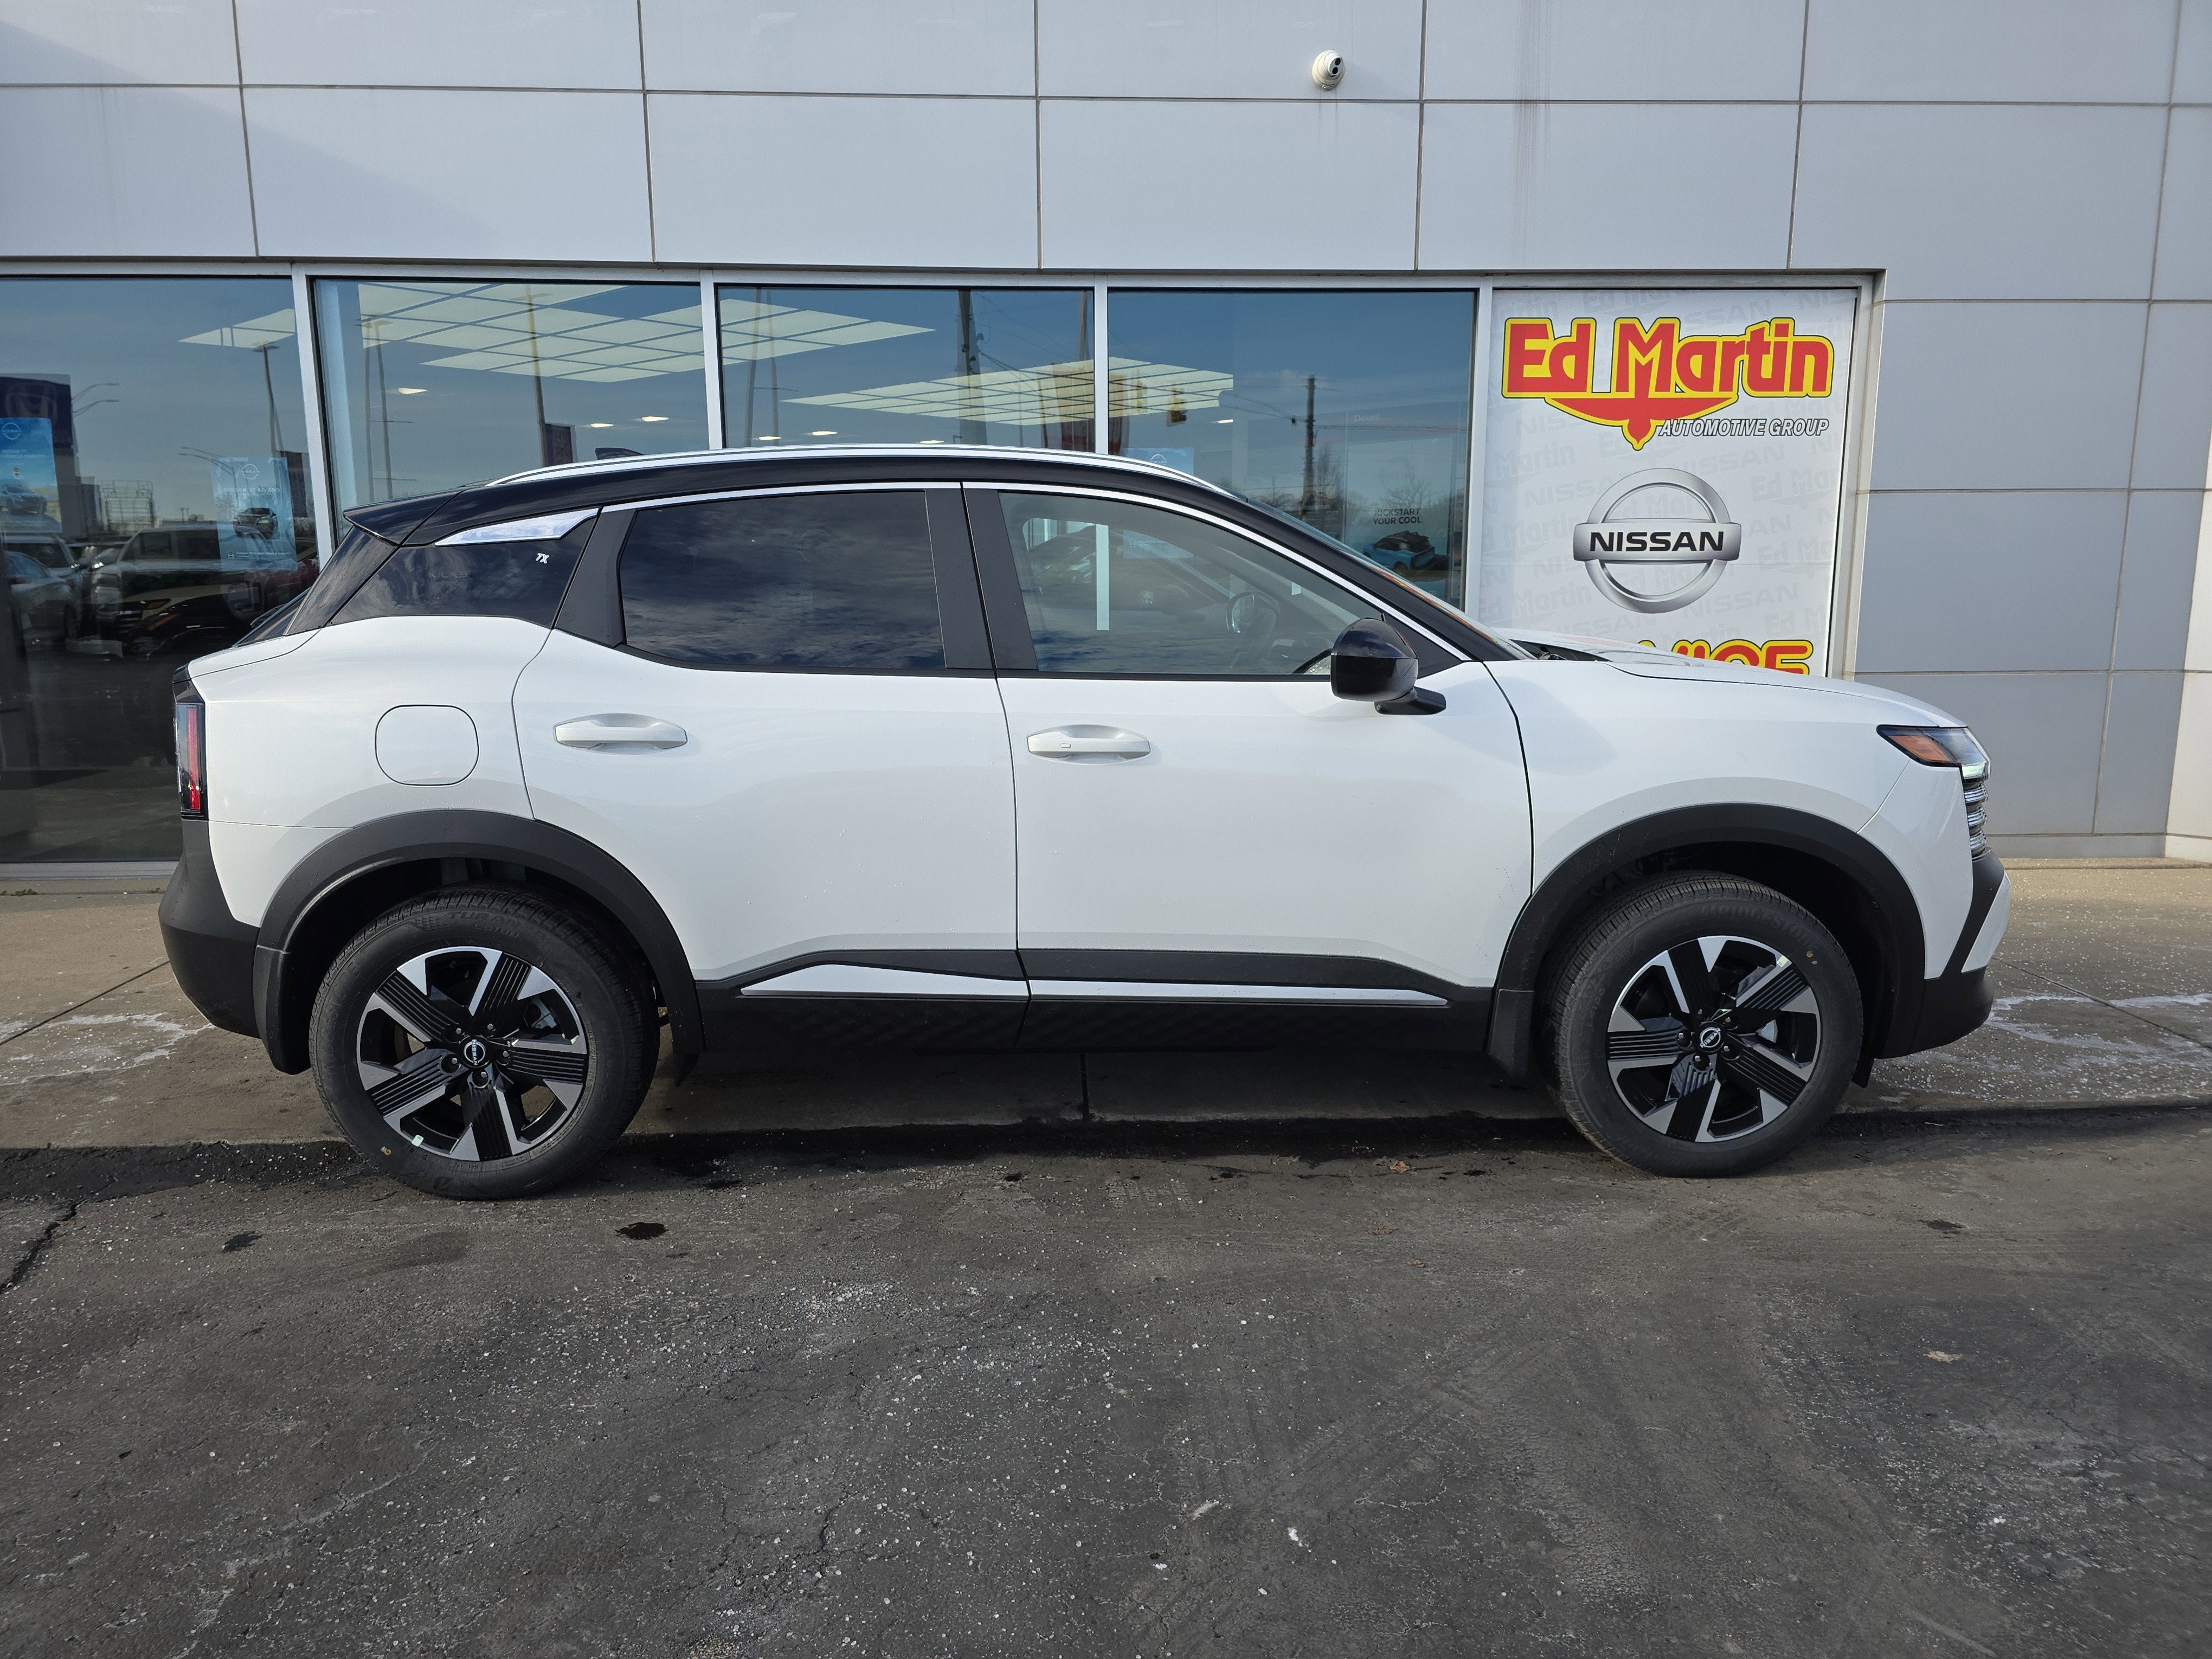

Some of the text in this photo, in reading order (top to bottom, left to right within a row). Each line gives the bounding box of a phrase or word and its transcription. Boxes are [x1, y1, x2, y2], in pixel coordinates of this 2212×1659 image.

[1502, 317, 1835, 398] Ed Martin
[1354, 414, 1380, 422] Detail
[1658, 417, 1830, 437] AUTOMOTIVE GROUP
[1374, 508, 1422, 517] KICKSTART
[1373, 517, 1397, 525] YOUR
[1589, 531, 1724, 552] NISSAN
